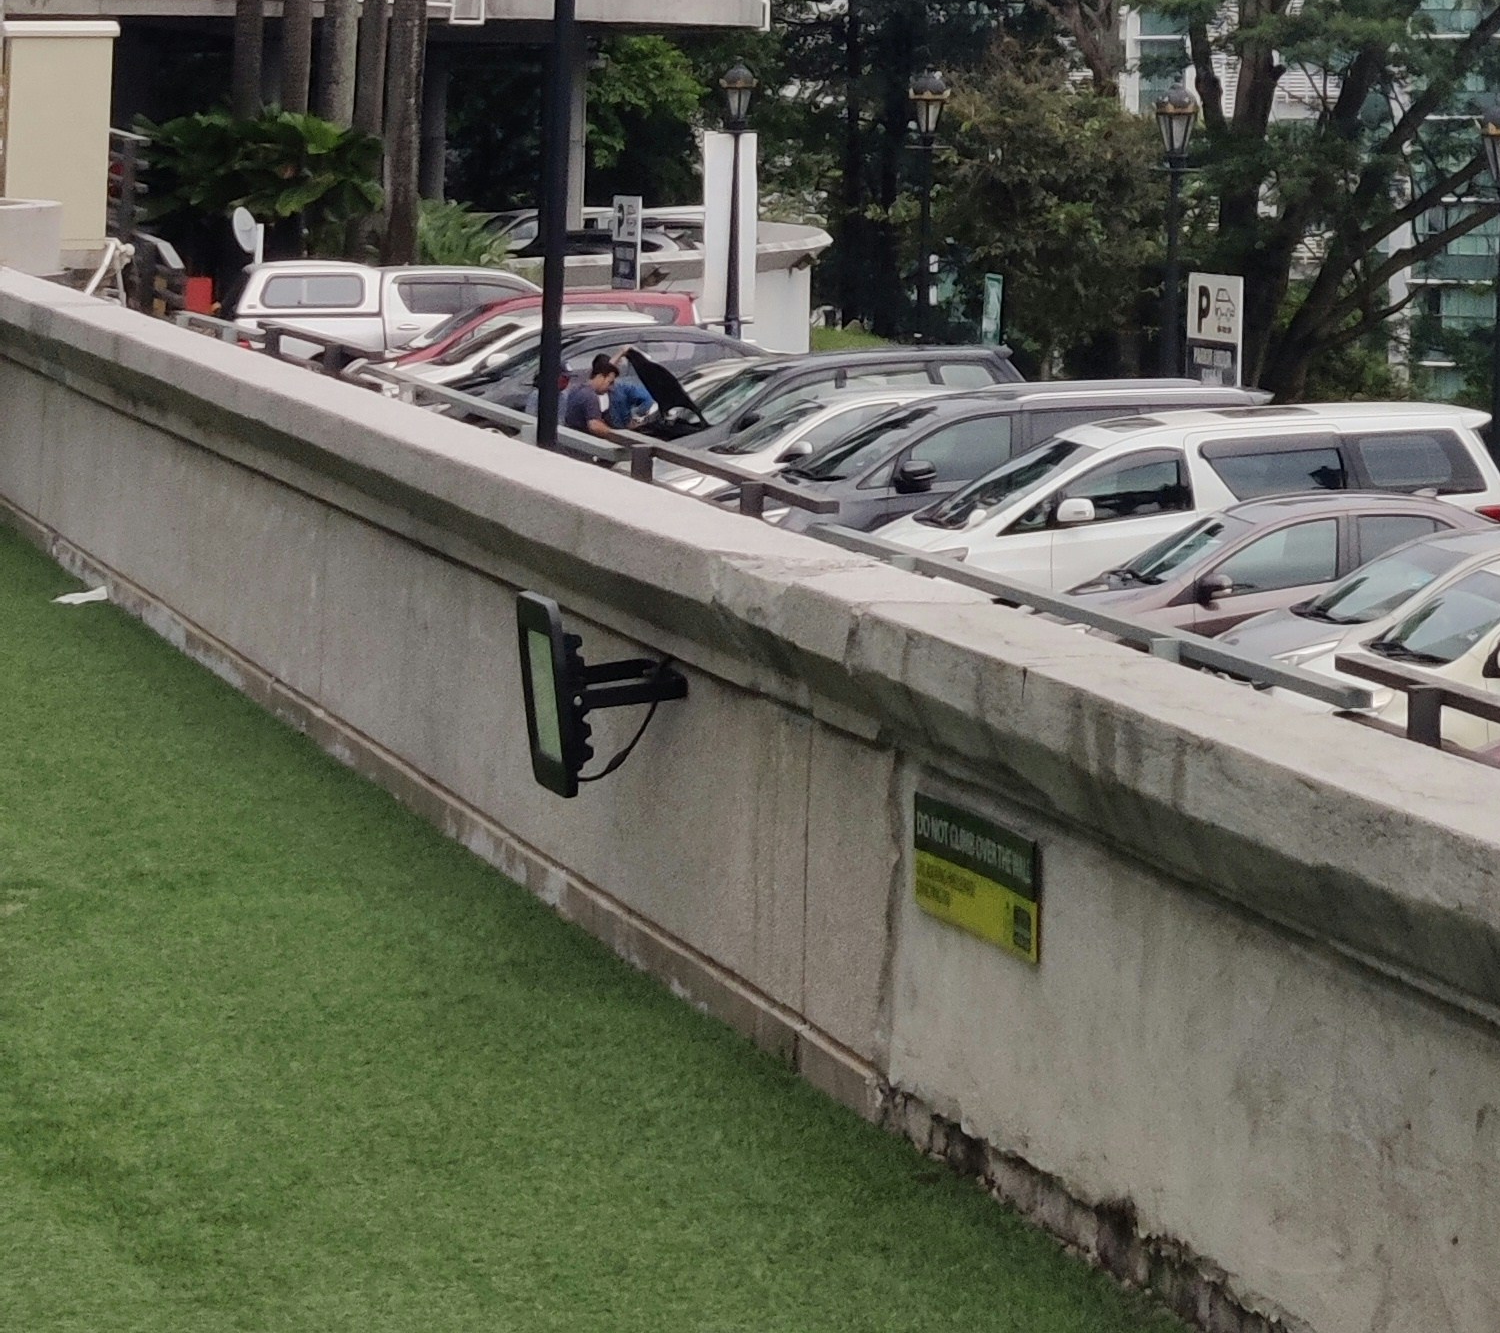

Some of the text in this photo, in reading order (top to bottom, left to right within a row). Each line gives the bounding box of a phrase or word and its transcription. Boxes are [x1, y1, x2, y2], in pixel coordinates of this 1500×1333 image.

[1197, 284, 1211, 334] P
[916, 811, 930, 837] DO
[931, 819, 949, 846] NOT
[976, 836, 997, 865] OVER
